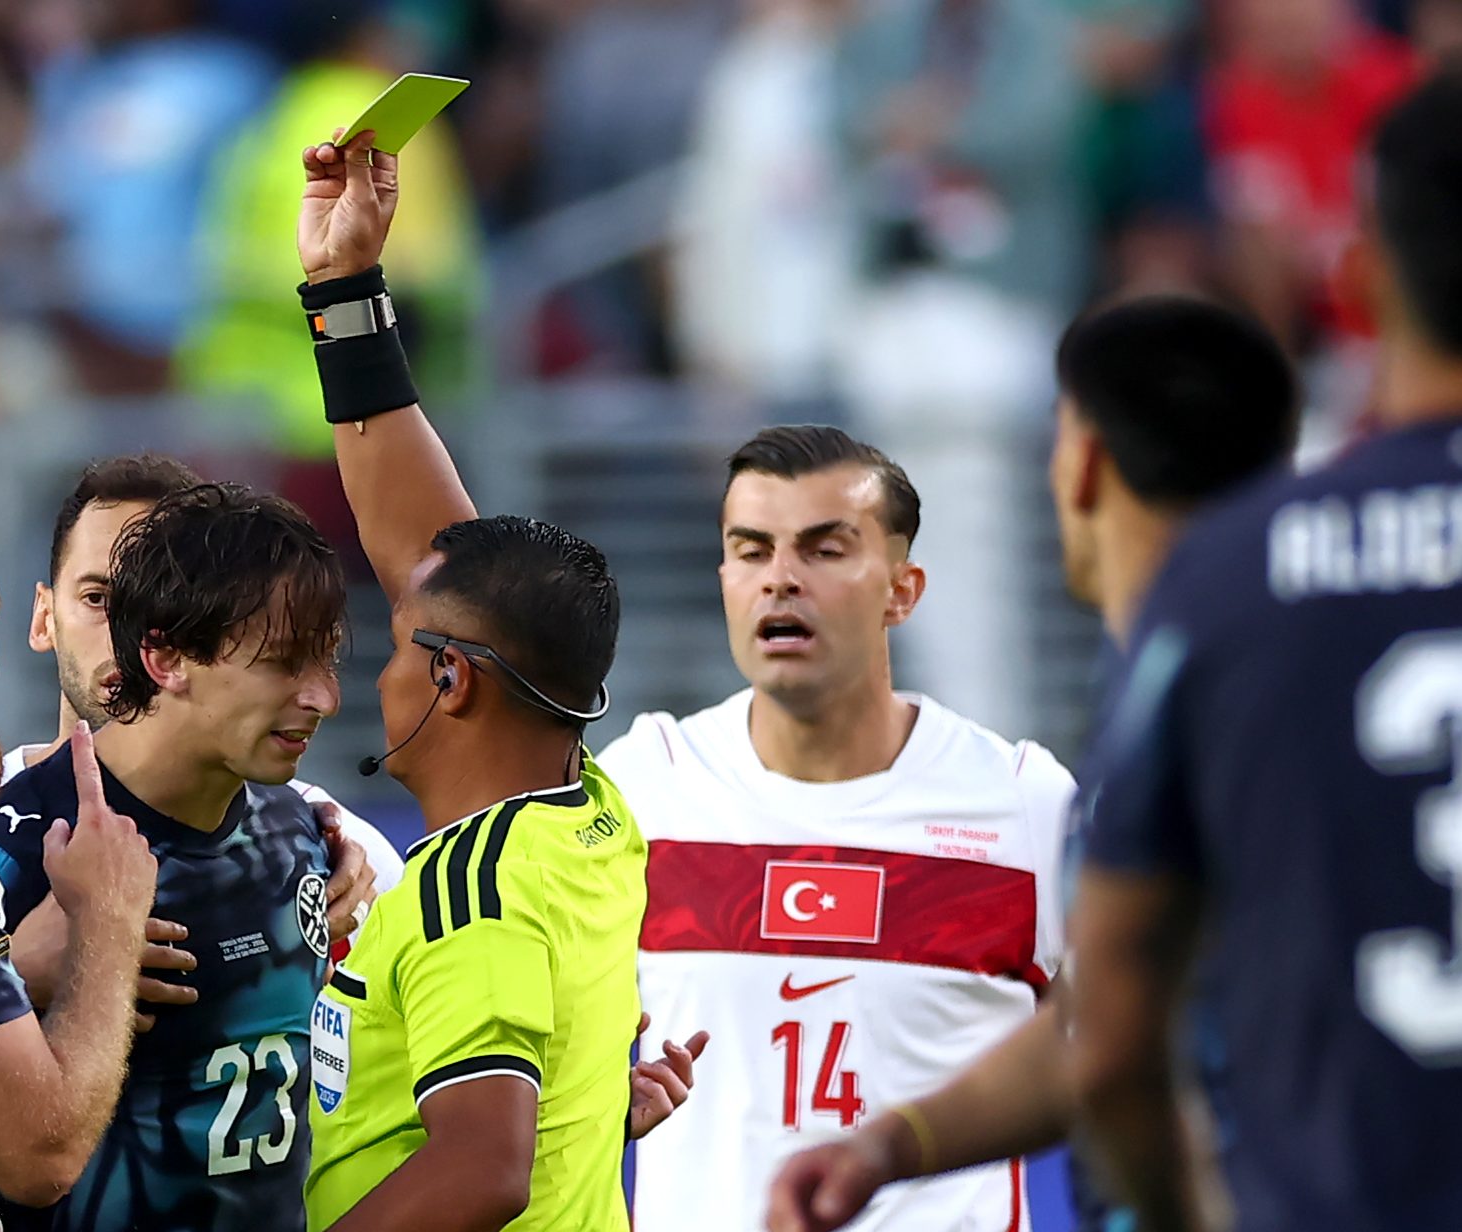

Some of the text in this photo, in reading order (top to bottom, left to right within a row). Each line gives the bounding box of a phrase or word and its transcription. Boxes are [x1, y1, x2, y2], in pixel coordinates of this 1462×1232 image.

[314, 1000, 344, 1040] FIFA
[313, 1045, 345, 1074] REFEREE
[771, 1020, 865, 1132] 14
[206, 1033, 298, 1176] 23
